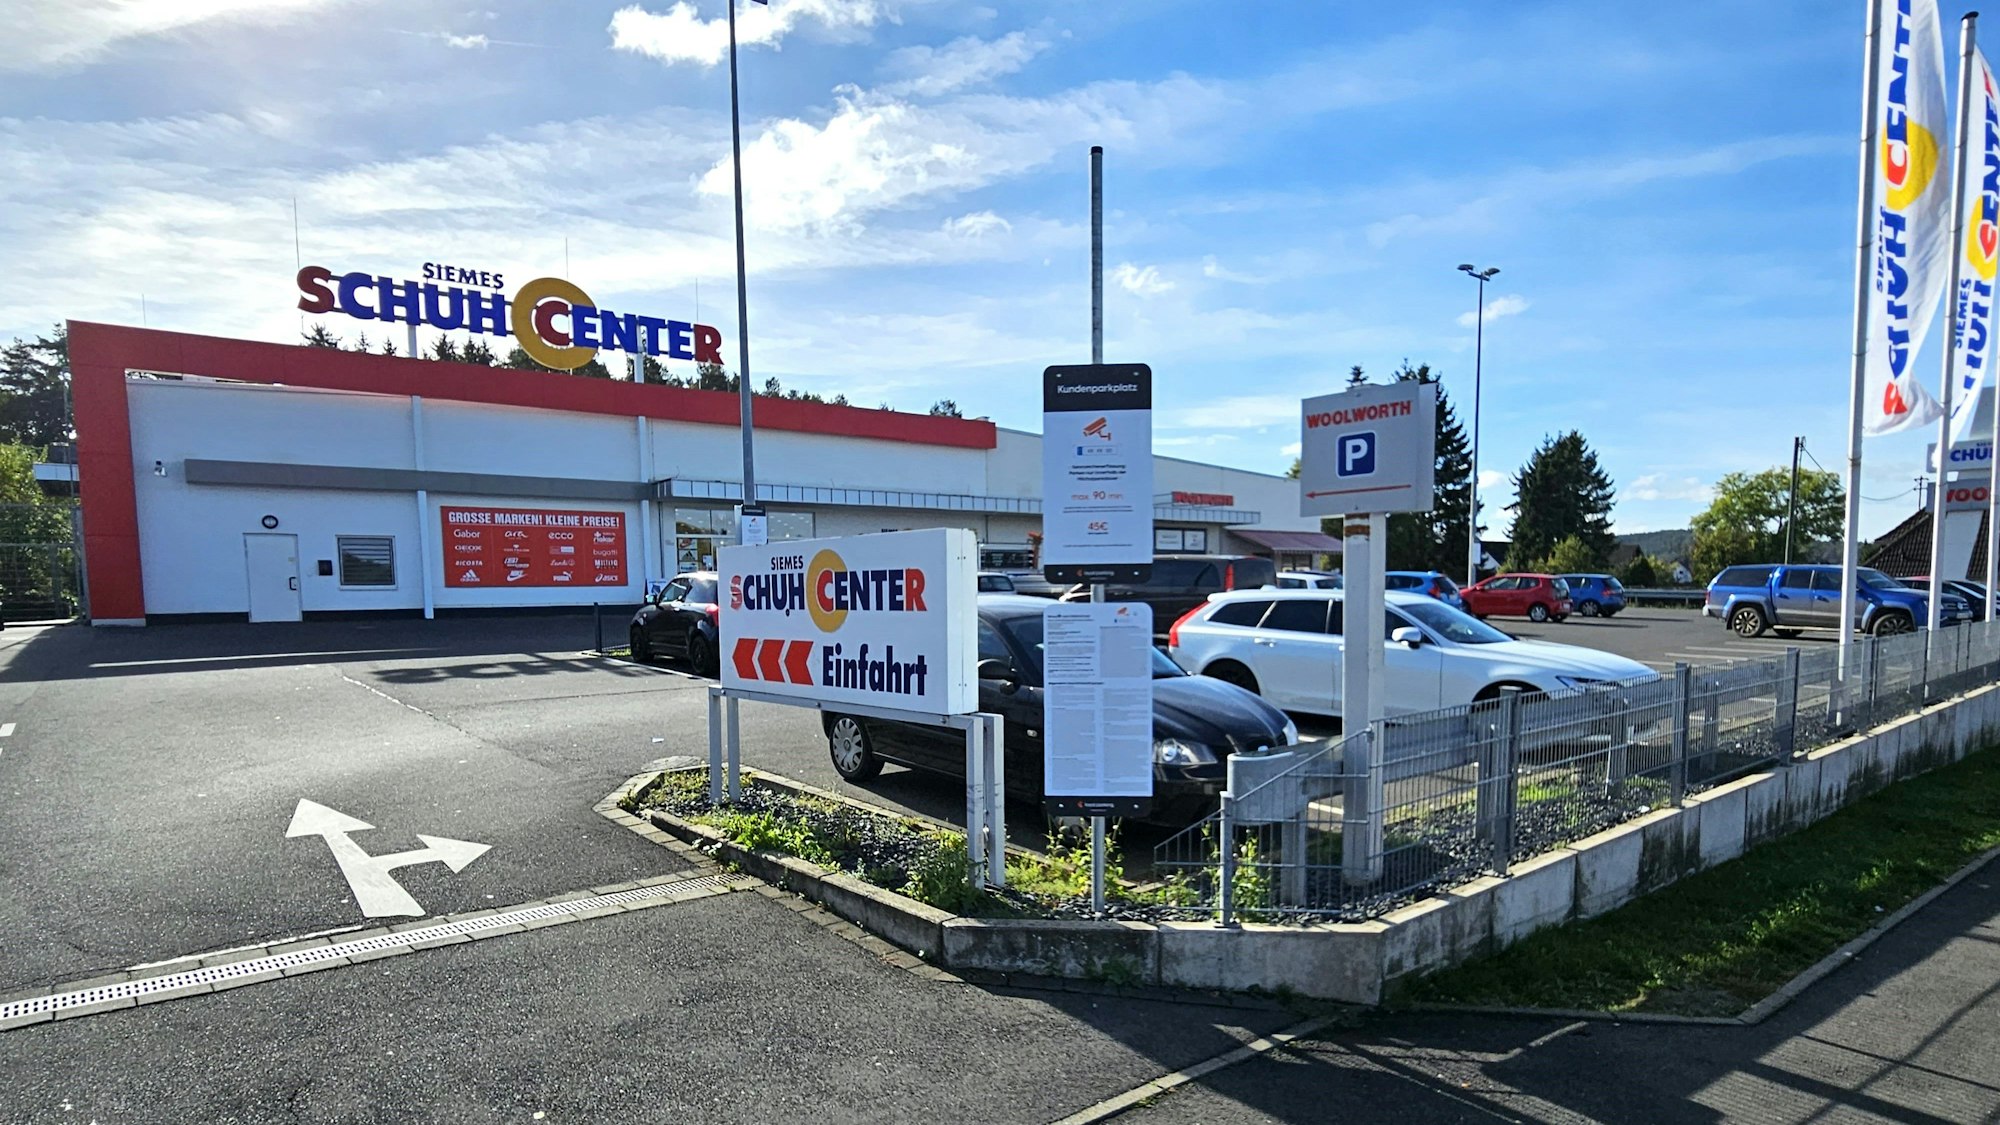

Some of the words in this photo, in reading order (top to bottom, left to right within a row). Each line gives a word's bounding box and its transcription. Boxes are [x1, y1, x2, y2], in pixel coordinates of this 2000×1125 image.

[422, 261, 504, 289] SIEMES
[297, 265, 508, 337] SCHUH
[534, 299, 724, 366] CENTER
[1955, 278, 1972, 349] SIEMES
[1057, 383, 1139, 394] Kundenparkplatz
[1306, 400, 1411, 428] WOOLWORTH
[1345, 438, 1368, 471] P
[1092, 490, 1106, 500] 90
[448, 511, 491, 524] GROSSE
[494, 513, 543, 526] MARKEN!
[545, 515, 580, 527] KLEINE
[583, 516, 620, 528] PREISE!
[1088, 521, 1108, 531] 45€
[453, 528, 481, 539] Gabor
[548, 532, 574, 540] ecco
[771, 555, 804, 571] SIEMES
[730, 573, 805, 611] SCHUH
[816, 568, 928, 613] CENTER
[822, 643, 928, 696] Einfahrt
